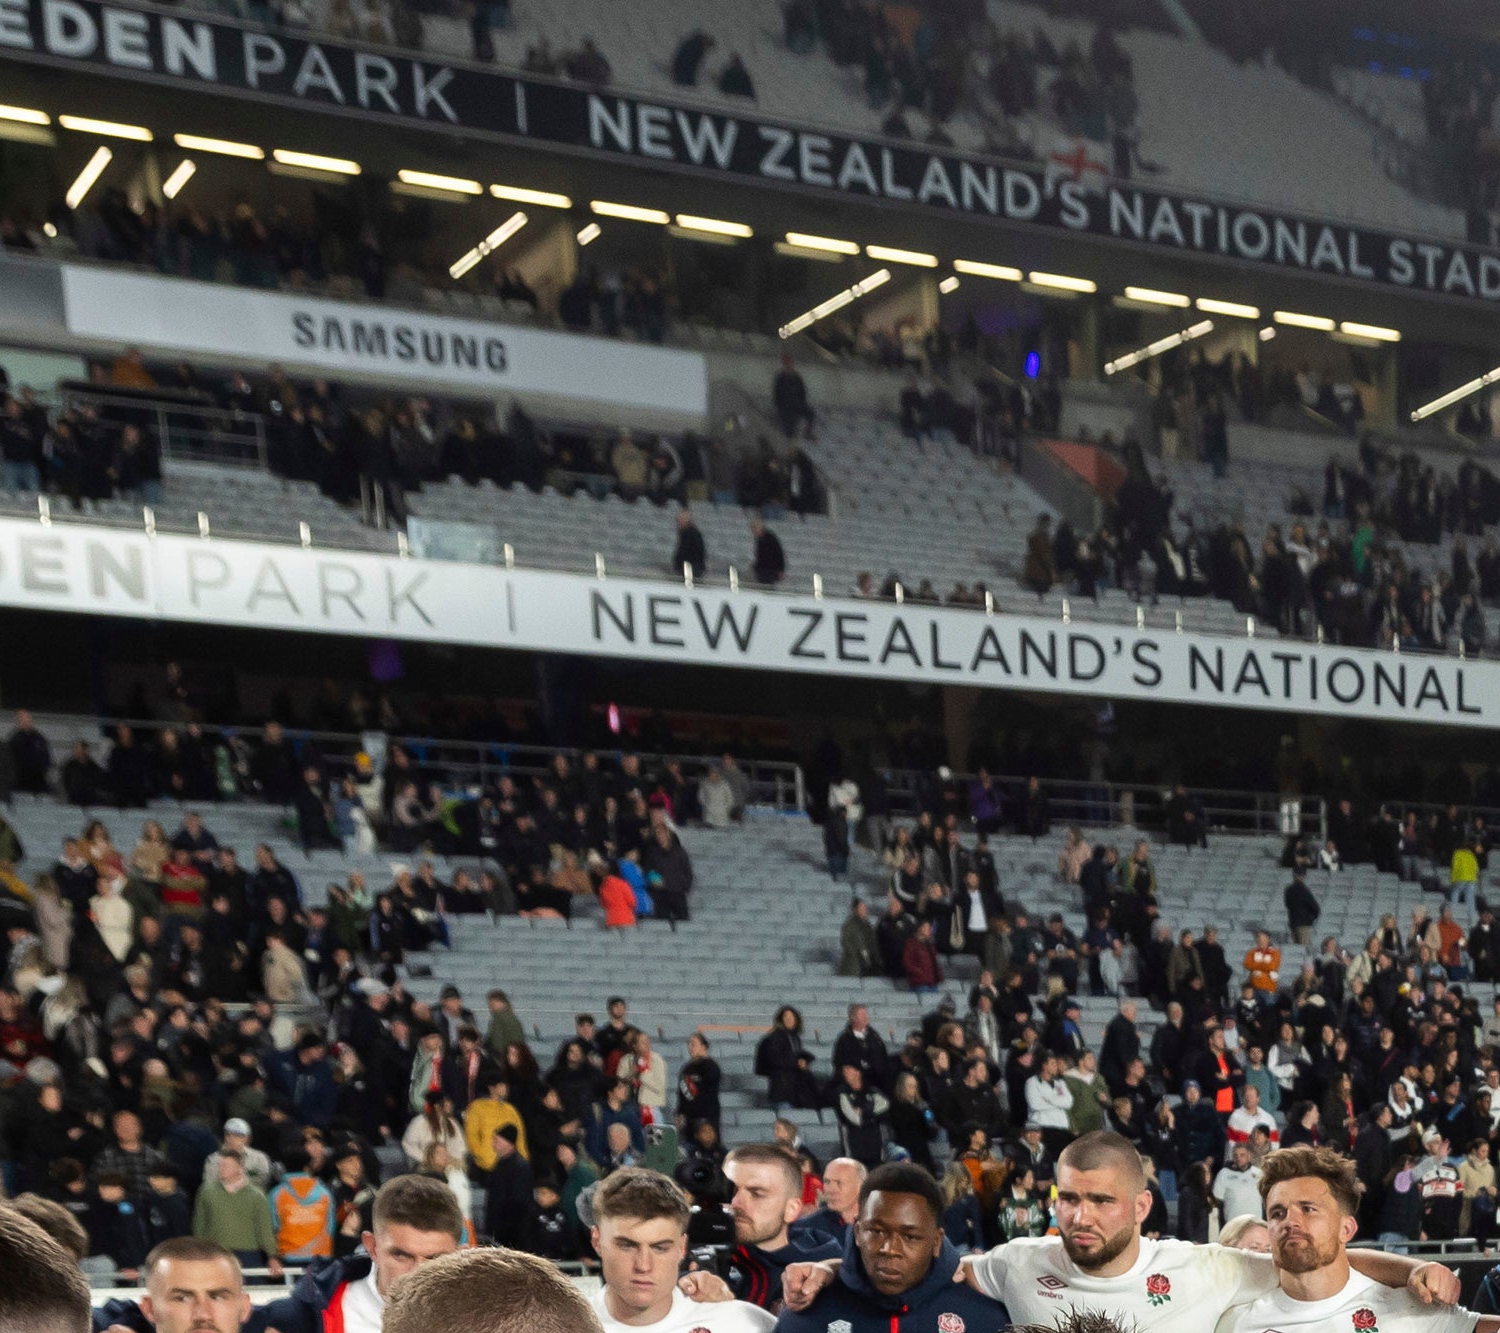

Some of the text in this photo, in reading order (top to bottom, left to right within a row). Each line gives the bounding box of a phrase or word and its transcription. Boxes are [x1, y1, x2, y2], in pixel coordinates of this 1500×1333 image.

[244, 38, 461, 123] PARK
[589, 95, 738, 170] NEW
[758, 125, 1091, 231] ZEALAND'S
[1109, 197, 1373, 280] NATIONAL
[290, 310, 509, 372] SAMSUNG
[184, 547, 436, 628] PARK
[591, 591, 759, 653] NEW
[789, 608, 1163, 688] ZEALAND'S
[1188, 644, 1481, 714] NATIONAL
[1037, 1289, 1064, 1300] umbro
